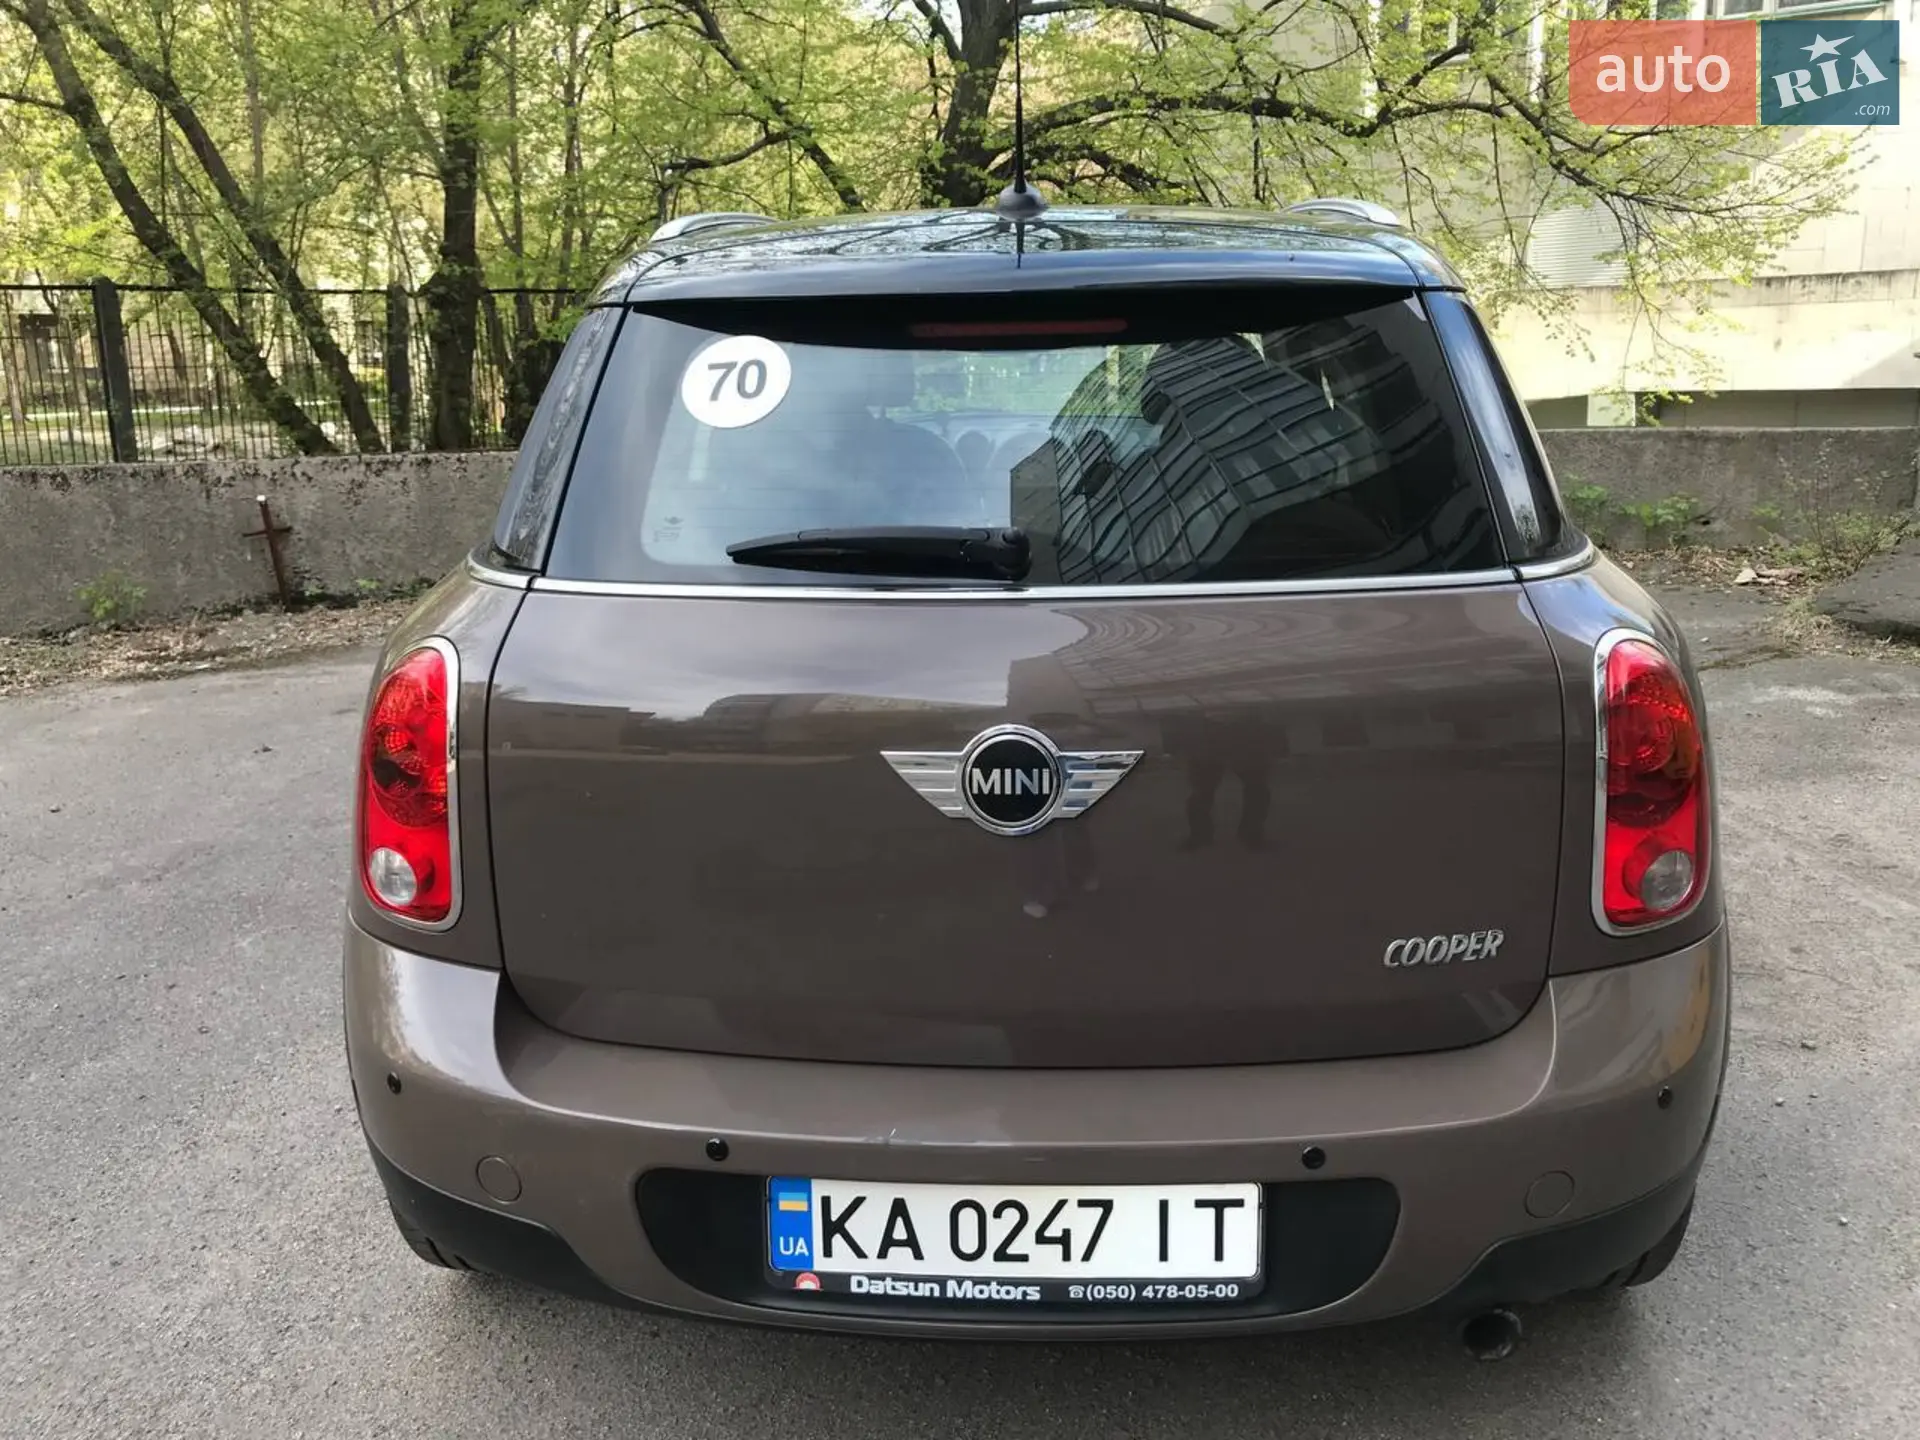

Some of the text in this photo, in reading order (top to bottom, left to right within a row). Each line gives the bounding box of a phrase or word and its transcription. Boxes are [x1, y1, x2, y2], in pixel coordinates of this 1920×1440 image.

[707, 359, 767, 402] 70
[972, 768, 1050, 795] MINI
[1383, 929, 1504, 968] COOPER
[820, 1195, 925, 1261] KA
[948, 1198, 1115, 1263] 0247
[779, 1236, 809, 1257] UA
[850, 1274, 1239, 1301] Datsun Motors (050) 478-05-00
